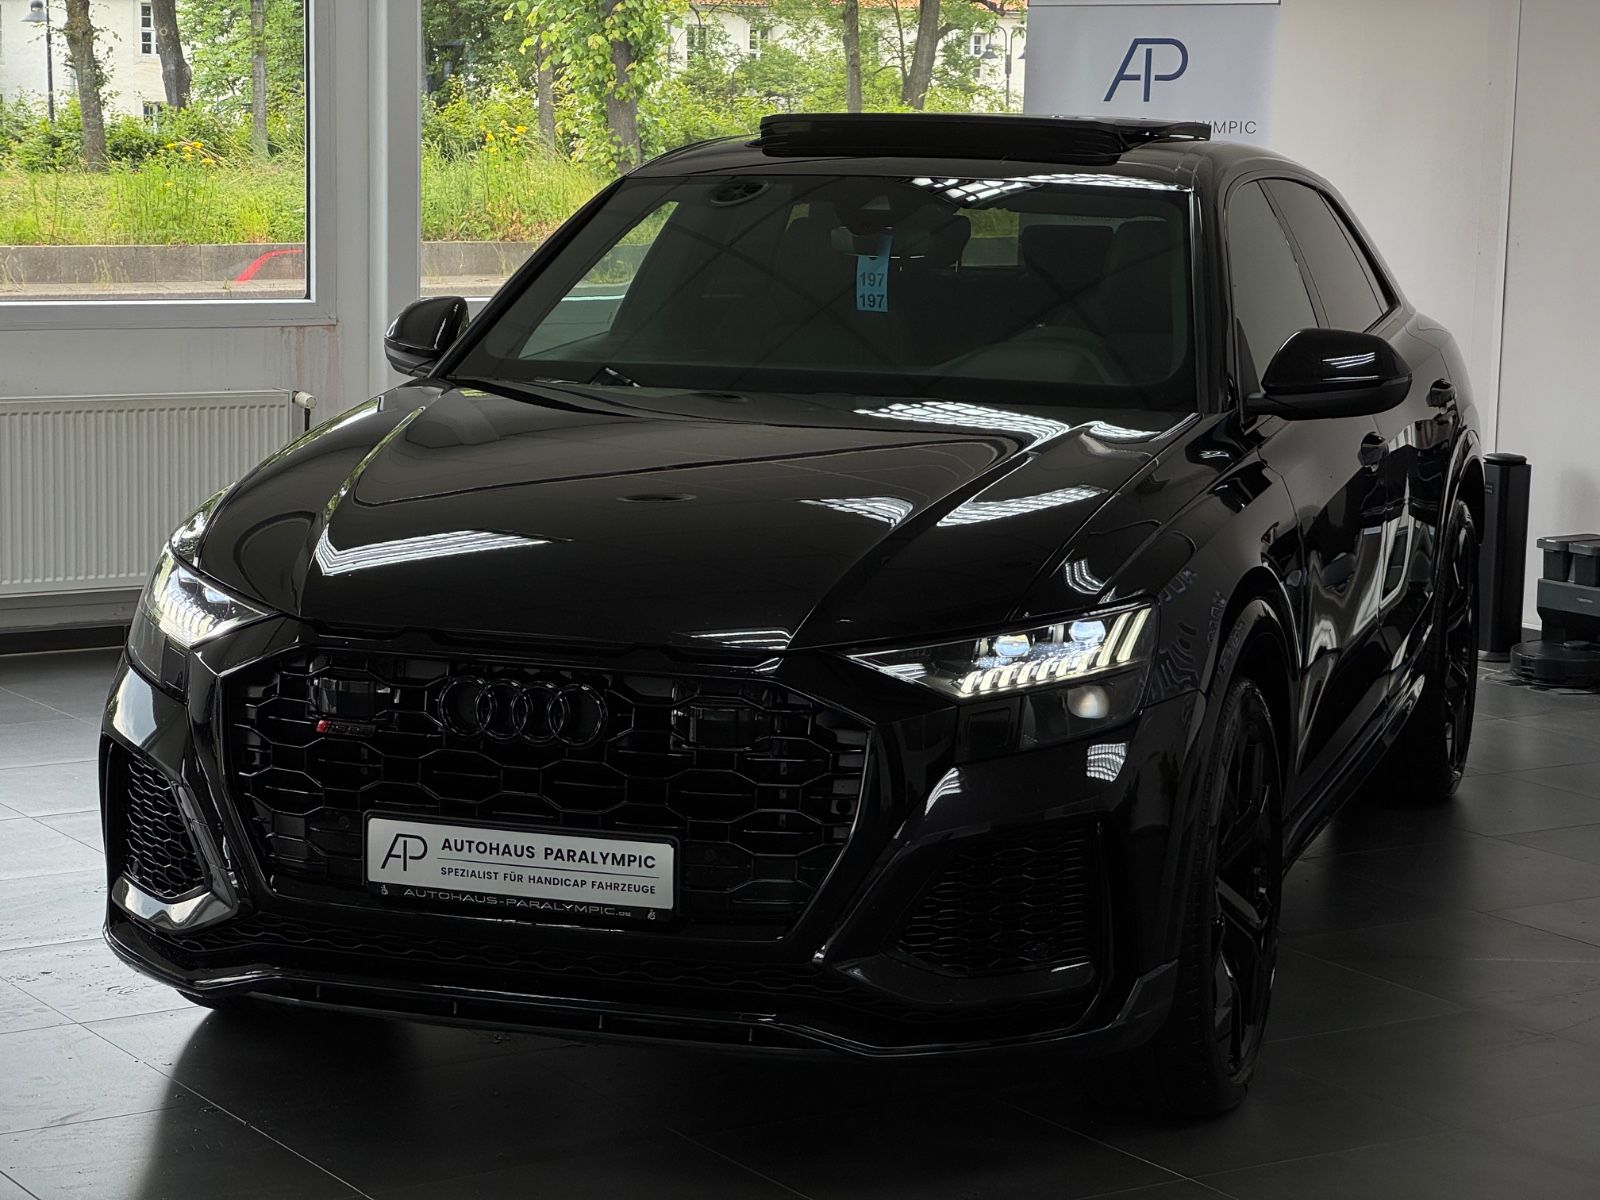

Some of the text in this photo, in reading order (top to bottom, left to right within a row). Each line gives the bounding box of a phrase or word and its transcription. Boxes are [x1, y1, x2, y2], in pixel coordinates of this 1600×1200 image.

[859, 271, 885, 287] 197
[859, 293, 885, 309] 197
[441, 838, 657, 869] AUTOHAUS PARALYMPIC
[440, 866, 656, 895] SPEZIALIST FÜR HANDICAP FAHRZEUGE
